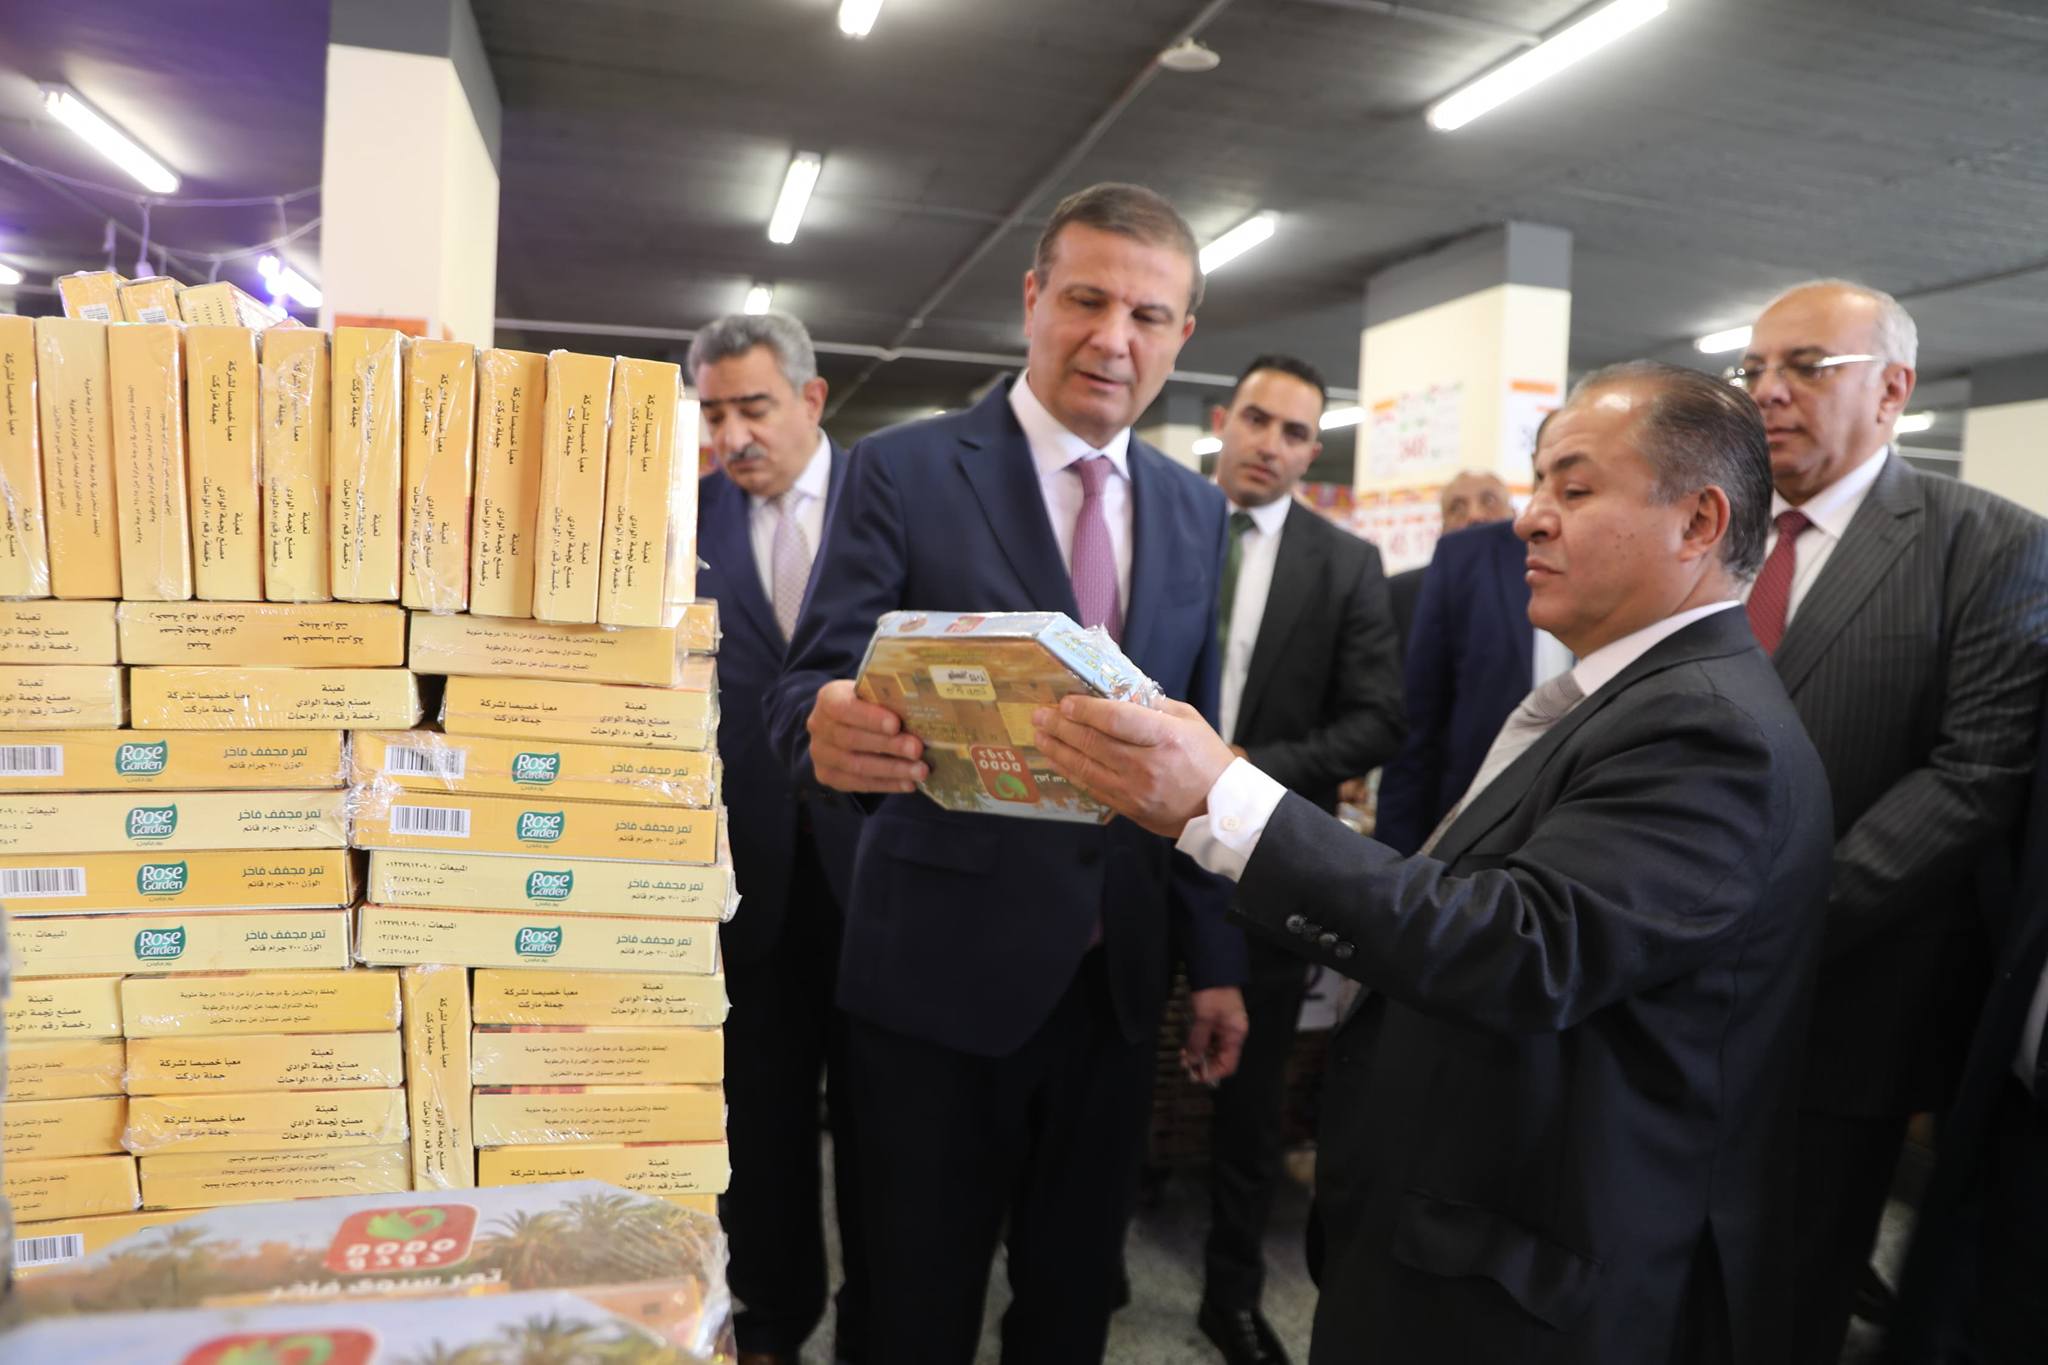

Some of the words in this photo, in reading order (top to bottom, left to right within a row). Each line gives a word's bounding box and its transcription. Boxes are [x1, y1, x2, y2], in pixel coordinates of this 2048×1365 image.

[120, 745, 163, 761] Rose
[224, 746, 247, 758] فاخر
[251, 748, 288, 756] مجفف
[291, 747, 307, 758] تمر
[979, 749, 1015, 761] دودو
[120, 759, 162, 771] Garden
[517, 754, 556, 770] Rose
[979, 760, 1022, 772] DODO
[516, 769, 555, 780] Garden
[132, 808, 173, 825] Rose
[238, 810, 261, 821] فاخر
[265, 810, 301, 819] مجفف
[305, 809, 321, 820] تمر
[522, 812, 560, 828] Rose
[131, 823, 172, 834] Garden
[521, 826, 559, 838] Garden
[615, 822, 637, 831] فاخر
[640, 824, 674, 833] مجفف
[676, 825, 692, 835] تمر
[142, 866, 182, 881] Rose
[242, 866, 265, 877] فاخر
[269, 866, 305, 875] مجفف
[308, 866, 324, 876] تمر
[142, 880, 183, 891] Garden
[531, 872, 568, 888] Rose
[627, 880, 649, 889] فاخر
[652, 880, 686, 890] مجفف
[531, 886, 568, 897] Garden
[688, 882, 703, 892] تمر
[140, 930, 180, 947] Rose
[245, 930, 268, 942] فاخر
[271, 930, 307, 940] مجفف
[310, 930, 325, 940] تمر
[520, 928, 558, 943] Rose
[616, 935, 638, 944] فاخر
[640, 936, 674, 945] مجفف
[520, 941, 557, 953] Garden
[677, 937, 691, 947] تمر
[140, 944, 181, 956] Garden
[345, 1239, 456, 1257] DODO
[347, 1253, 440, 1270] دودو
